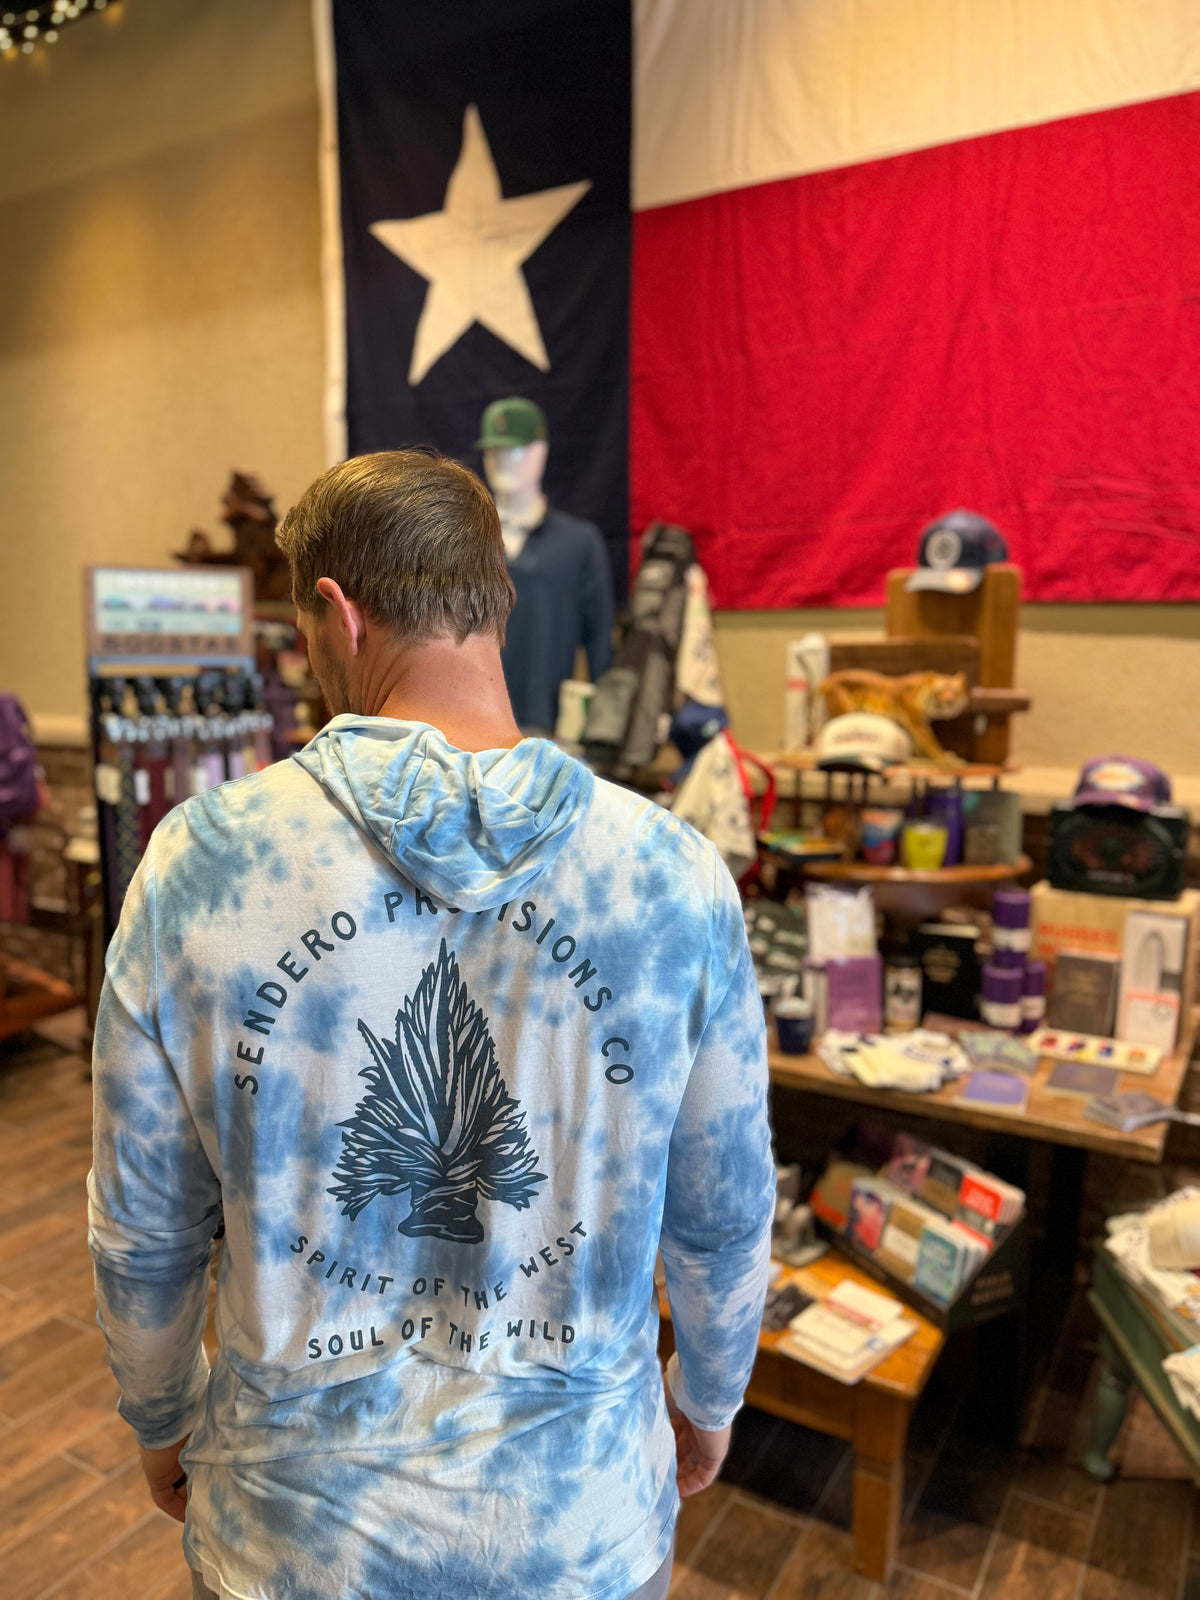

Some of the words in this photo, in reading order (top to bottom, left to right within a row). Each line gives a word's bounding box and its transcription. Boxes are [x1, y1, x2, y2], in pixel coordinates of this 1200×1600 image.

[234, 910, 357, 1096] SENDERO
[383, 887, 613, 1012] PRISIONS
[601, 1036, 635, 1085] CO
[289, 1235, 394, 1295] SPIRIT
[412, 1277, 445, 1296] OF
[460, 1280, 507, 1310] THE
[519, 1221, 588, 1278] WEST
[308, 1326, 384, 1359] SOUL
[401, 1317, 433, 1340] OF
[449, 1322, 491, 1353] THE
[507, 1319, 575, 1344] WILD
